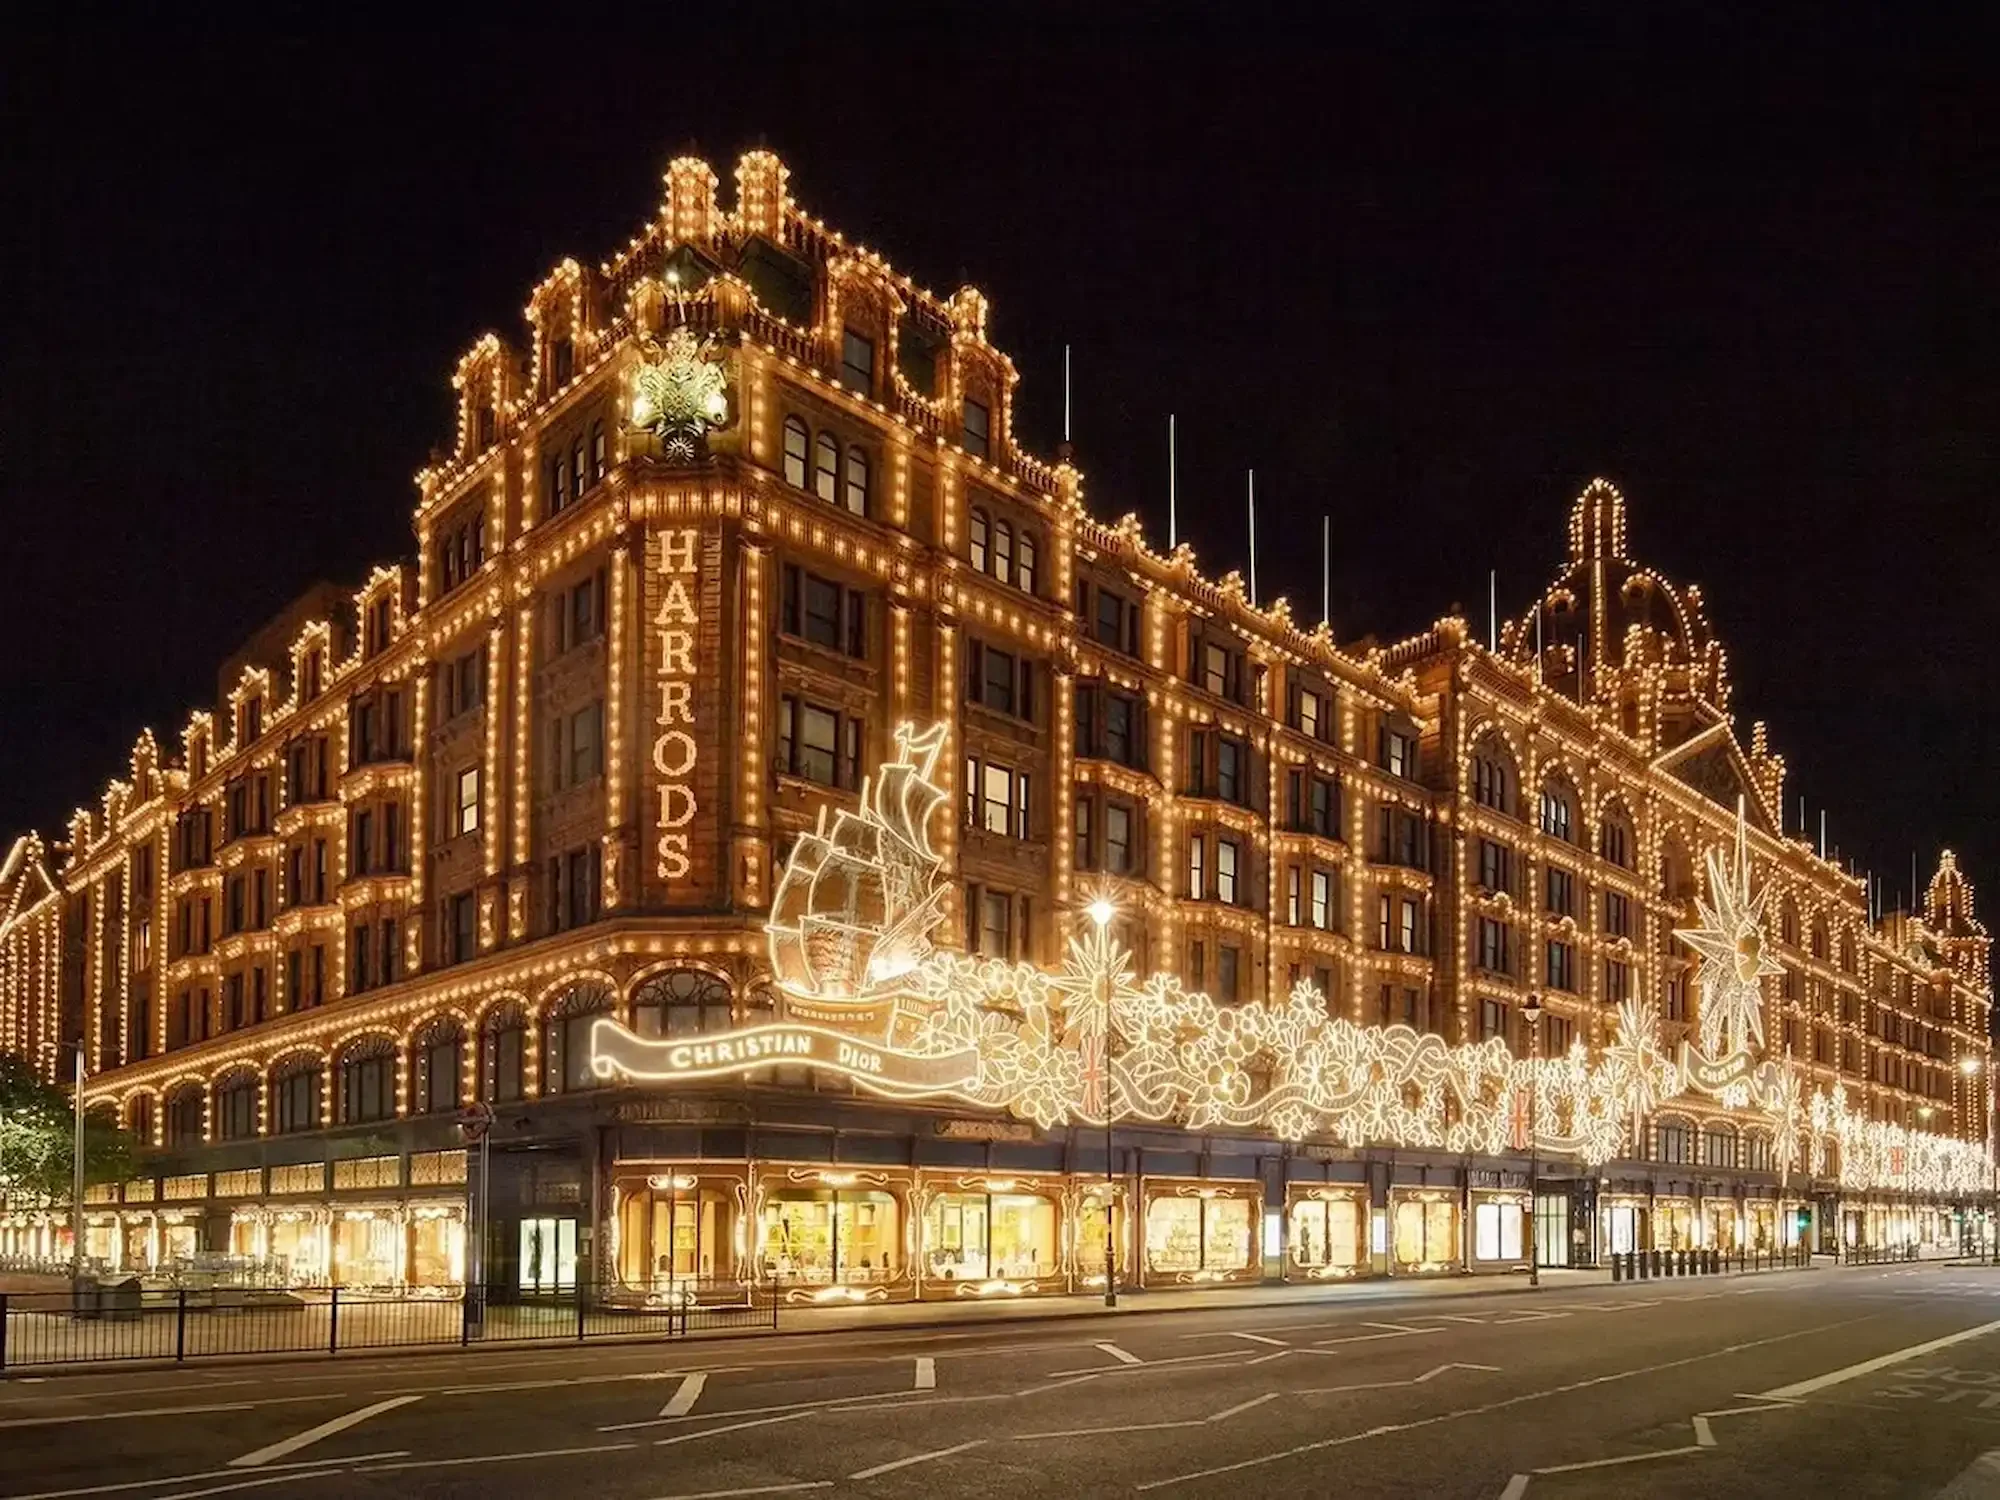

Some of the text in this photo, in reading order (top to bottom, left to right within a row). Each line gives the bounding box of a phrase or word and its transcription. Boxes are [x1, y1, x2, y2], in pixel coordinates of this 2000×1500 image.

[653, 529, 700, 880] HARRODS
[669, 1033, 884, 1073] CHRISTIAN DIOR
[1872, 1385, 2000, 1408] US
